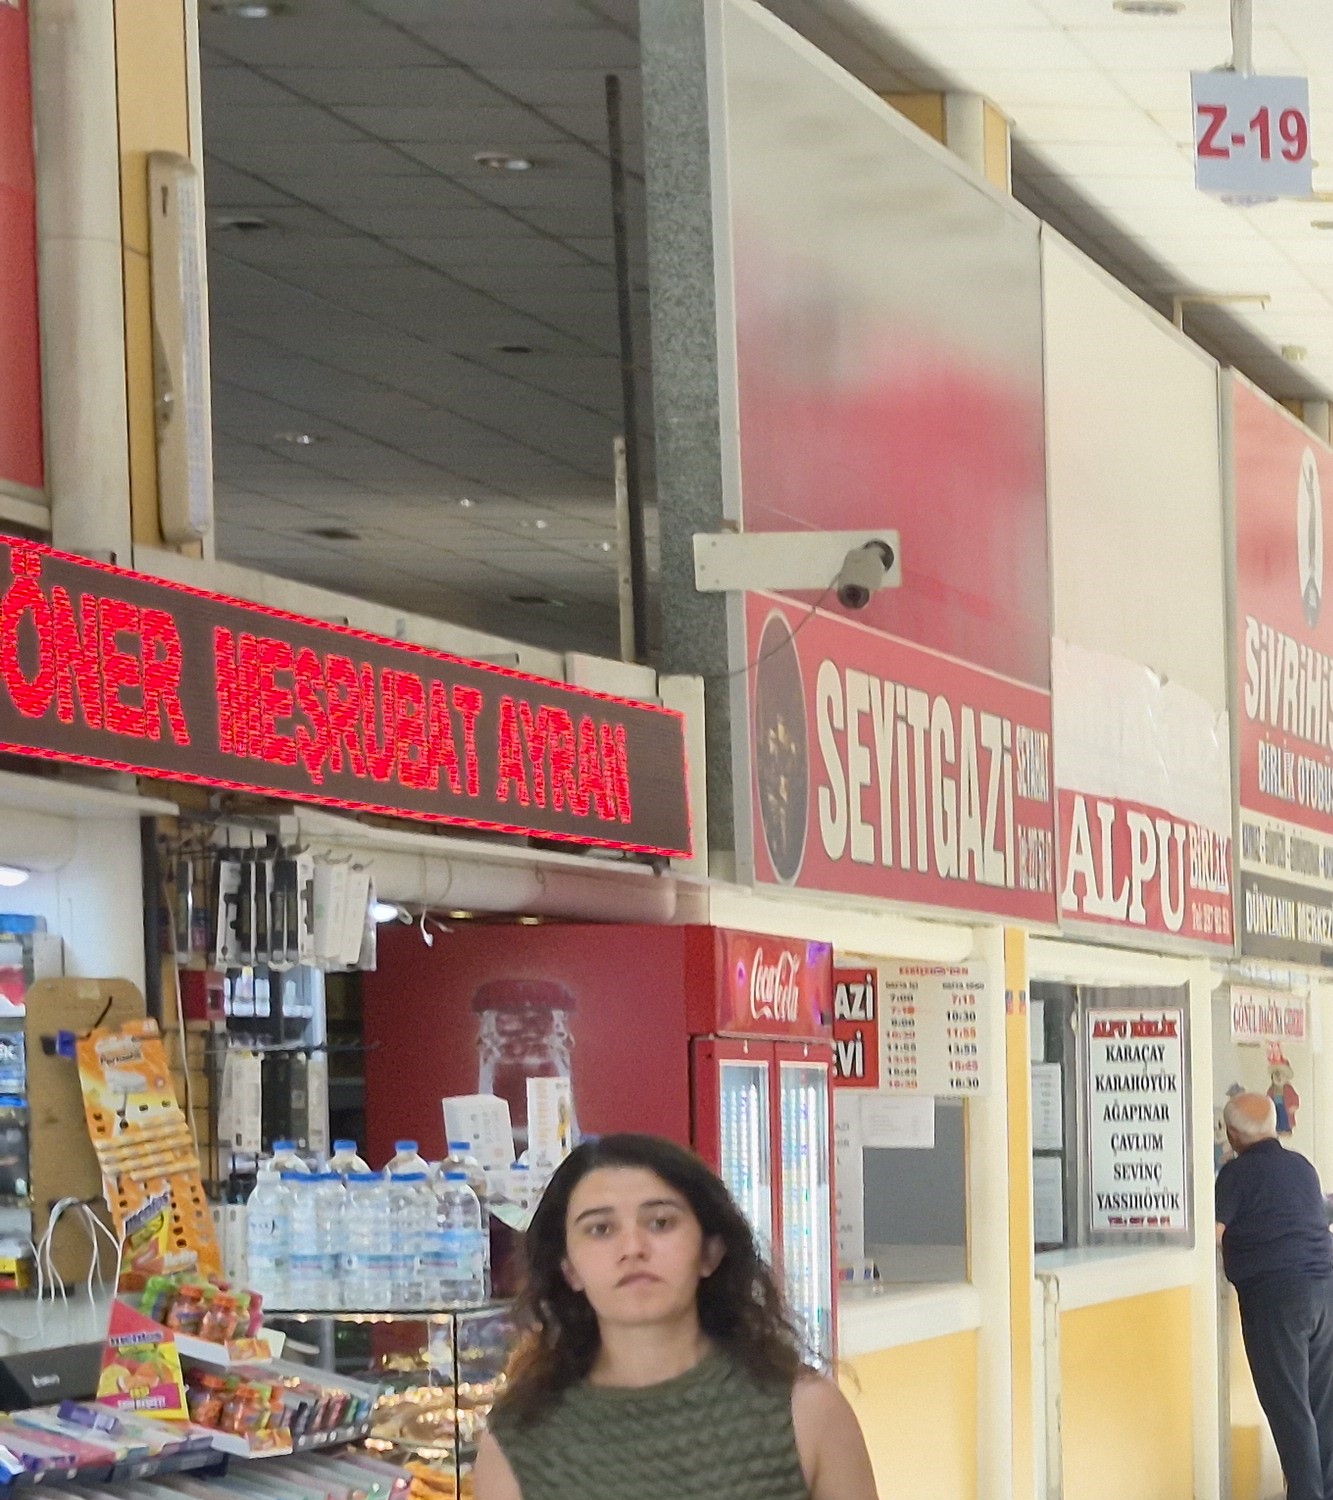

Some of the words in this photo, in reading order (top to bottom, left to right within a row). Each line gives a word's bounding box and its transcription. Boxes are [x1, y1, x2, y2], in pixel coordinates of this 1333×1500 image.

[1197, 105, 1308, 161] Z-19
[0, 545, 191, 747] ÖNER
[497, 695, 633, 824] AYRAN
[816, 658, 1015, 889] SEYİTGAZİ
[1258, 731, 1296, 802] BİRLİK
[1062, 794, 1186, 932] ALPU
[1245, 882, 1296, 941] DÜNYANIN
[835, 973, 874, 1022] AZİ
[1095, 1068, 1177, 1093] KARAHÖYÜK
[1105, 1044, 1166, 1070] KARAÇAY
[1103, 1099, 1170, 1122] AĞAPINAR
[1110, 1132, 1163, 1156] ÇAVLUM
[1113, 1157, 1162, 1186] SEVİNÇ
[1096, 1187, 1179, 1211] YASSIHÖYÜK
